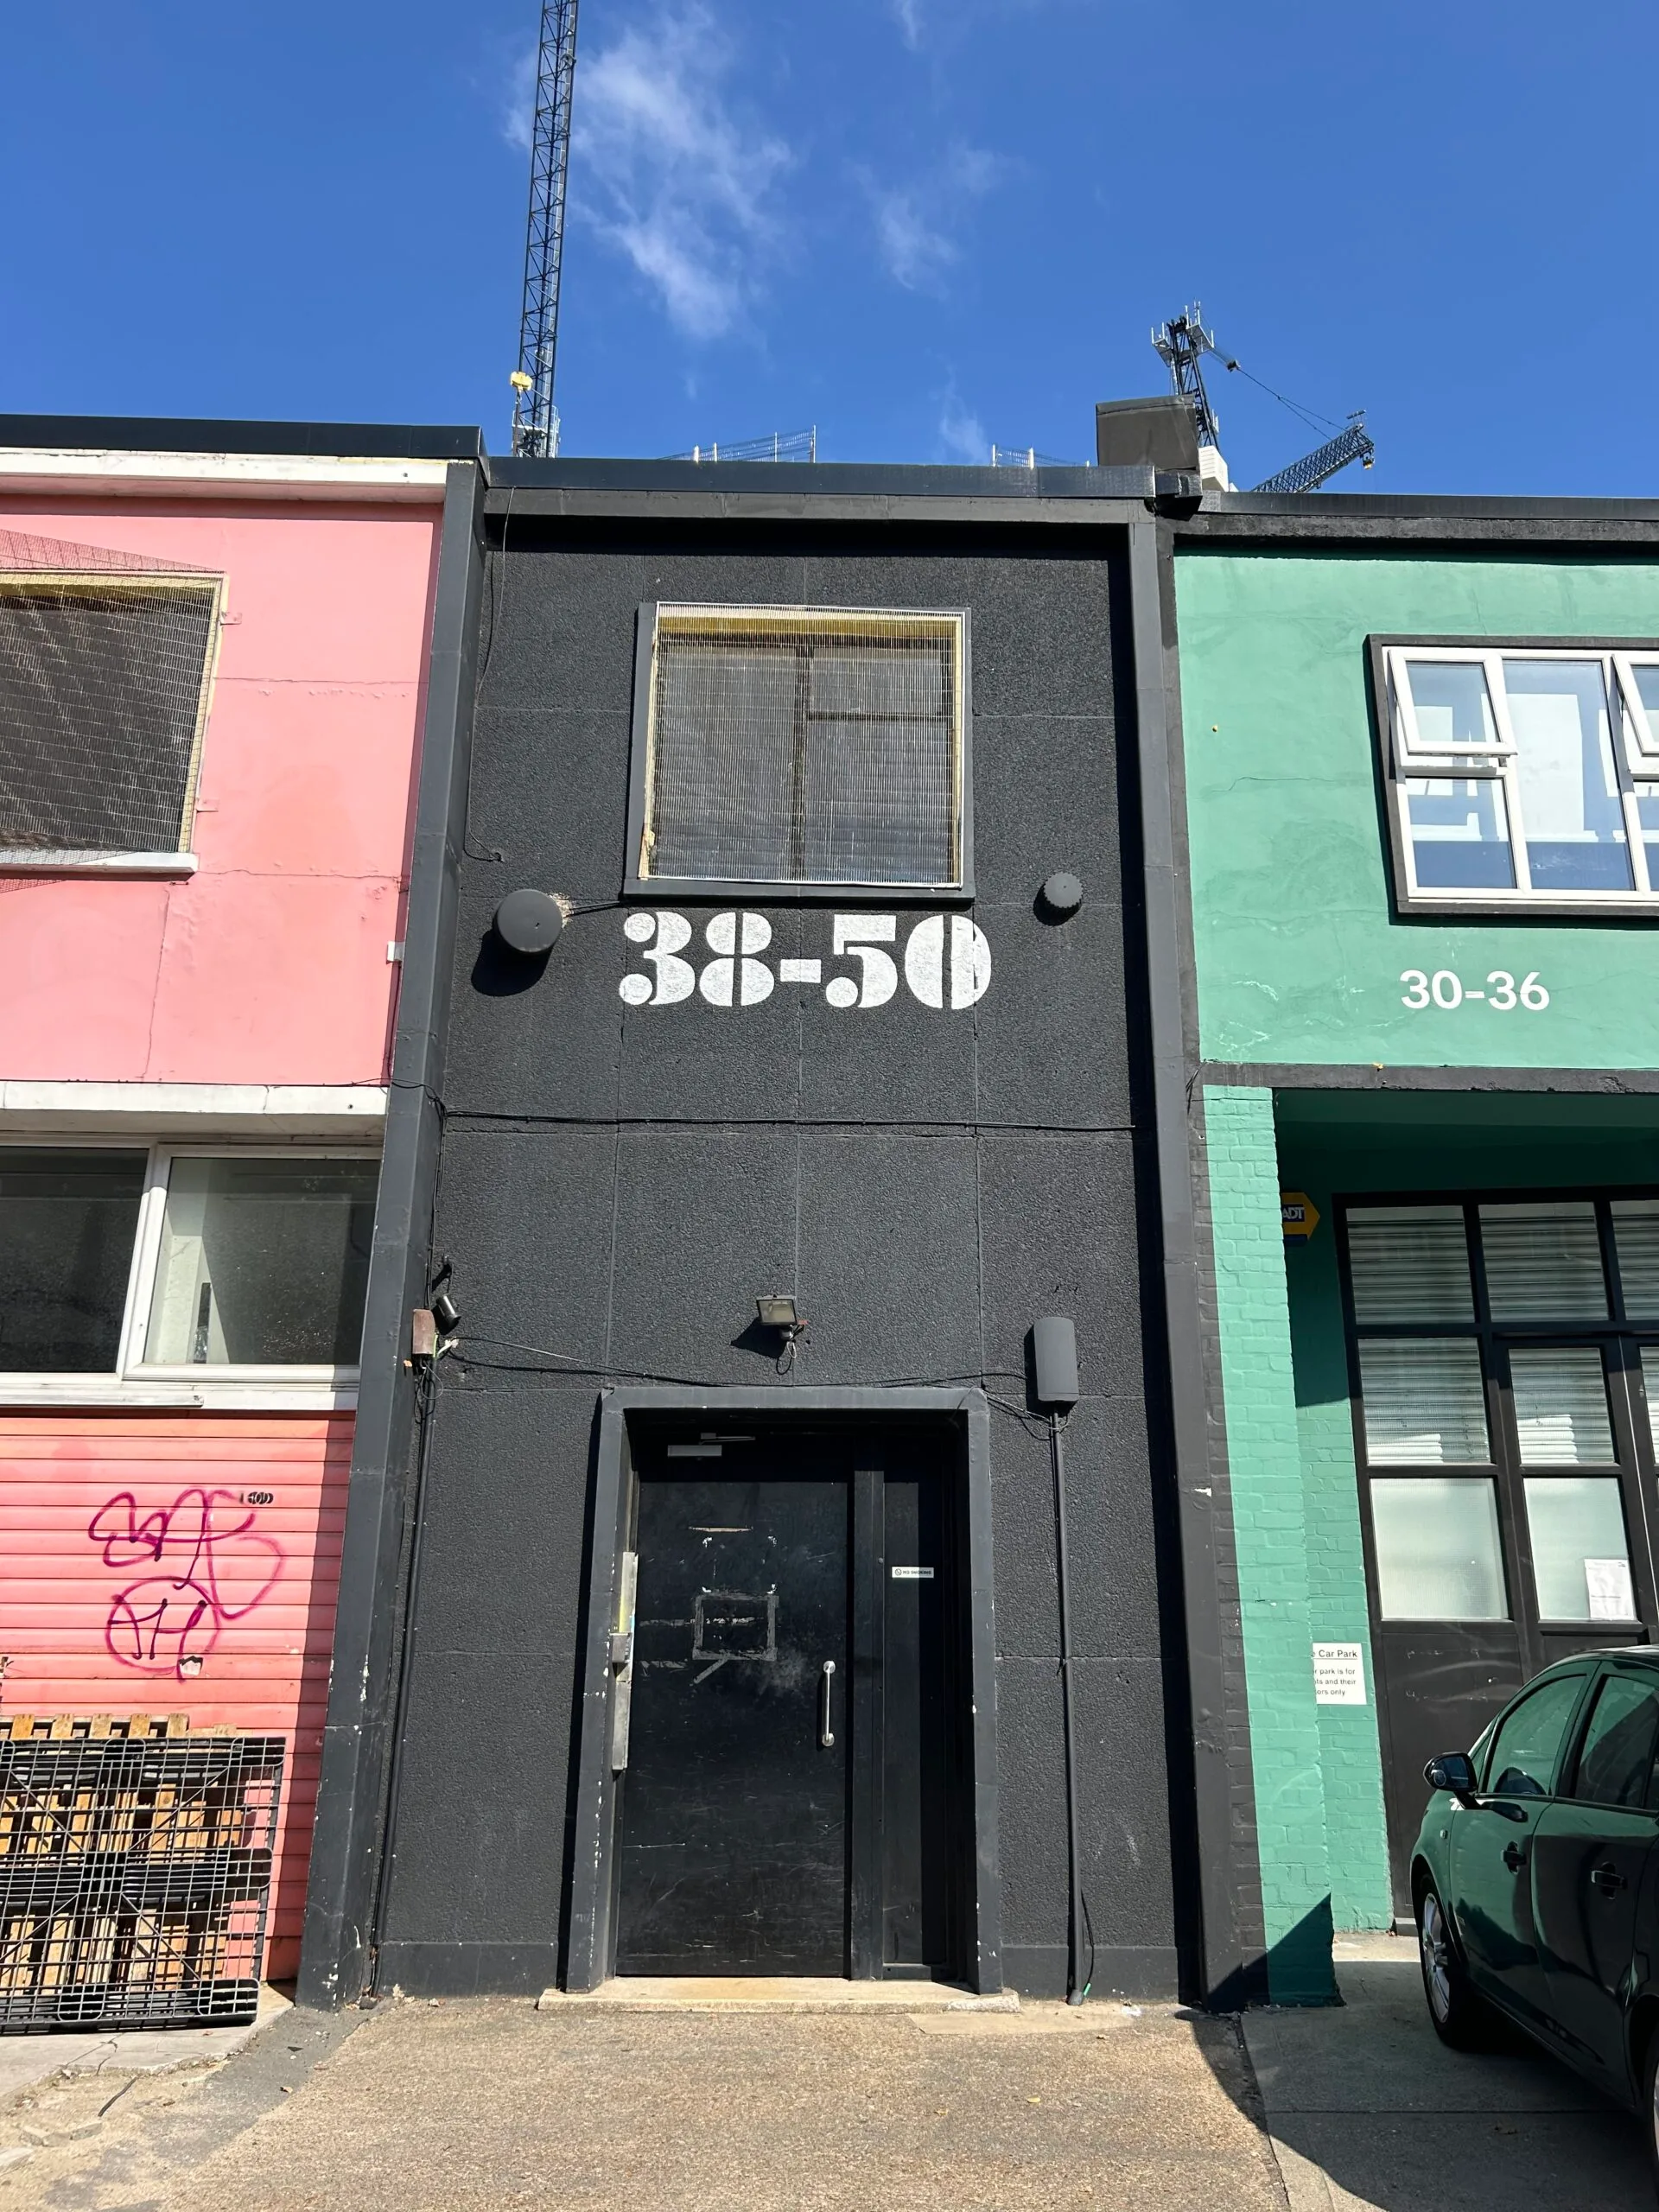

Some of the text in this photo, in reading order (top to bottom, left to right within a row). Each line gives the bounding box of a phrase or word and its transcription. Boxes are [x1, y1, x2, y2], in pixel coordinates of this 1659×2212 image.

[619, 911, 992, 1009] 38-50
[1400, 969, 1550, 1011] 30-36
[1282, 1206, 1305, 1219] ADT
[1319, 1649, 1334, 1658] Car
[1337, 1649, 1358, 1658] Park
[1330, 1688, 1345, 1697] only
